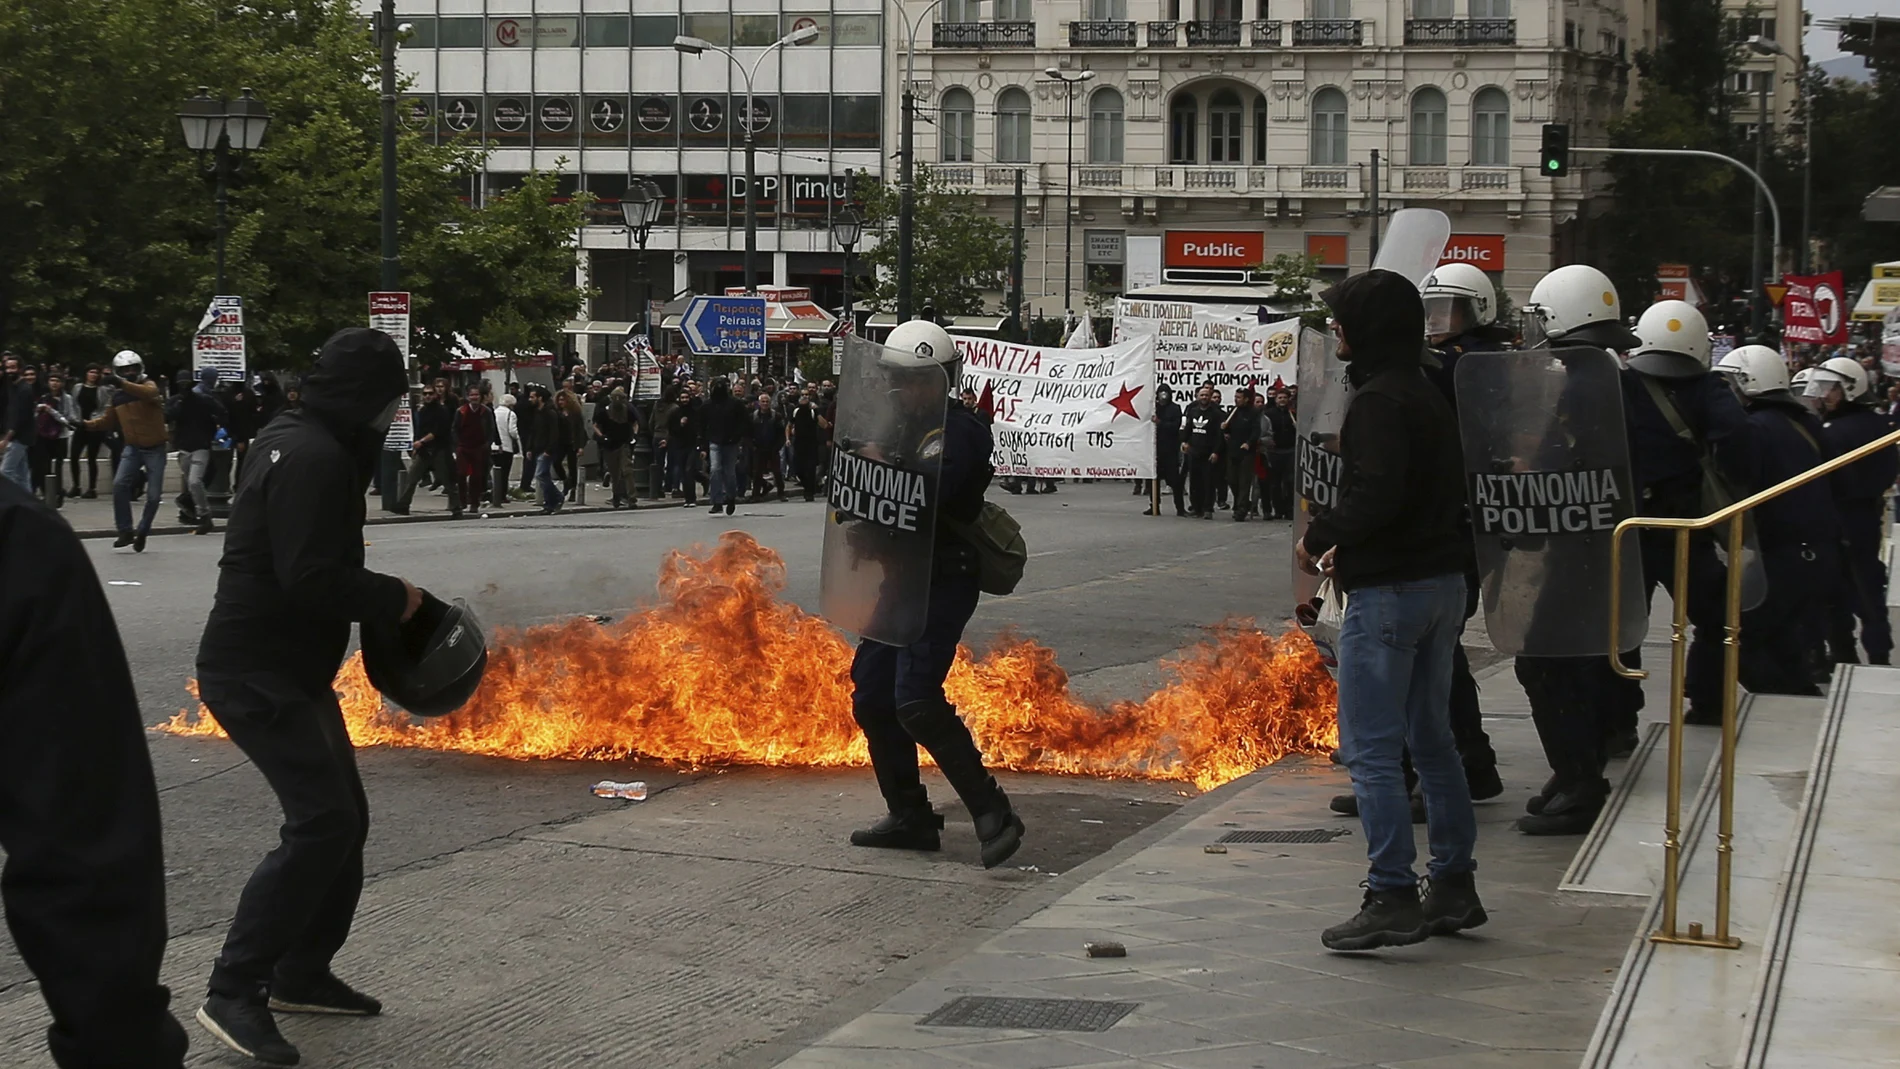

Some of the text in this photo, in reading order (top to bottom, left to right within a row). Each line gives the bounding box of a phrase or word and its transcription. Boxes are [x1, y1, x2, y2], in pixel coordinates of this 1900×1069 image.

[1183, 242, 1246, 257] Public
[1440, 245, 1492, 261] ublic
[719, 315, 762, 326] Peiraias
[1158, 320, 1198, 338] ΑΠΕΡΓΙΑ
[1047, 363, 1069, 378] σε
[1071, 353, 1117, 380] παλιά
[1031, 380, 1108, 405] μνημόνια
[1024, 412, 1053, 429] για
[1060, 410, 1087, 428] την
[832, 447, 926, 507] ΑΣΤΥΝΟΜΙΑ
[1476, 468, 1621, 507] ΑΣΤΥΝΟΜΙΑ
[831, 479, 918, 532] POLICE
[1482, 503, 1616, 534] POLICE
